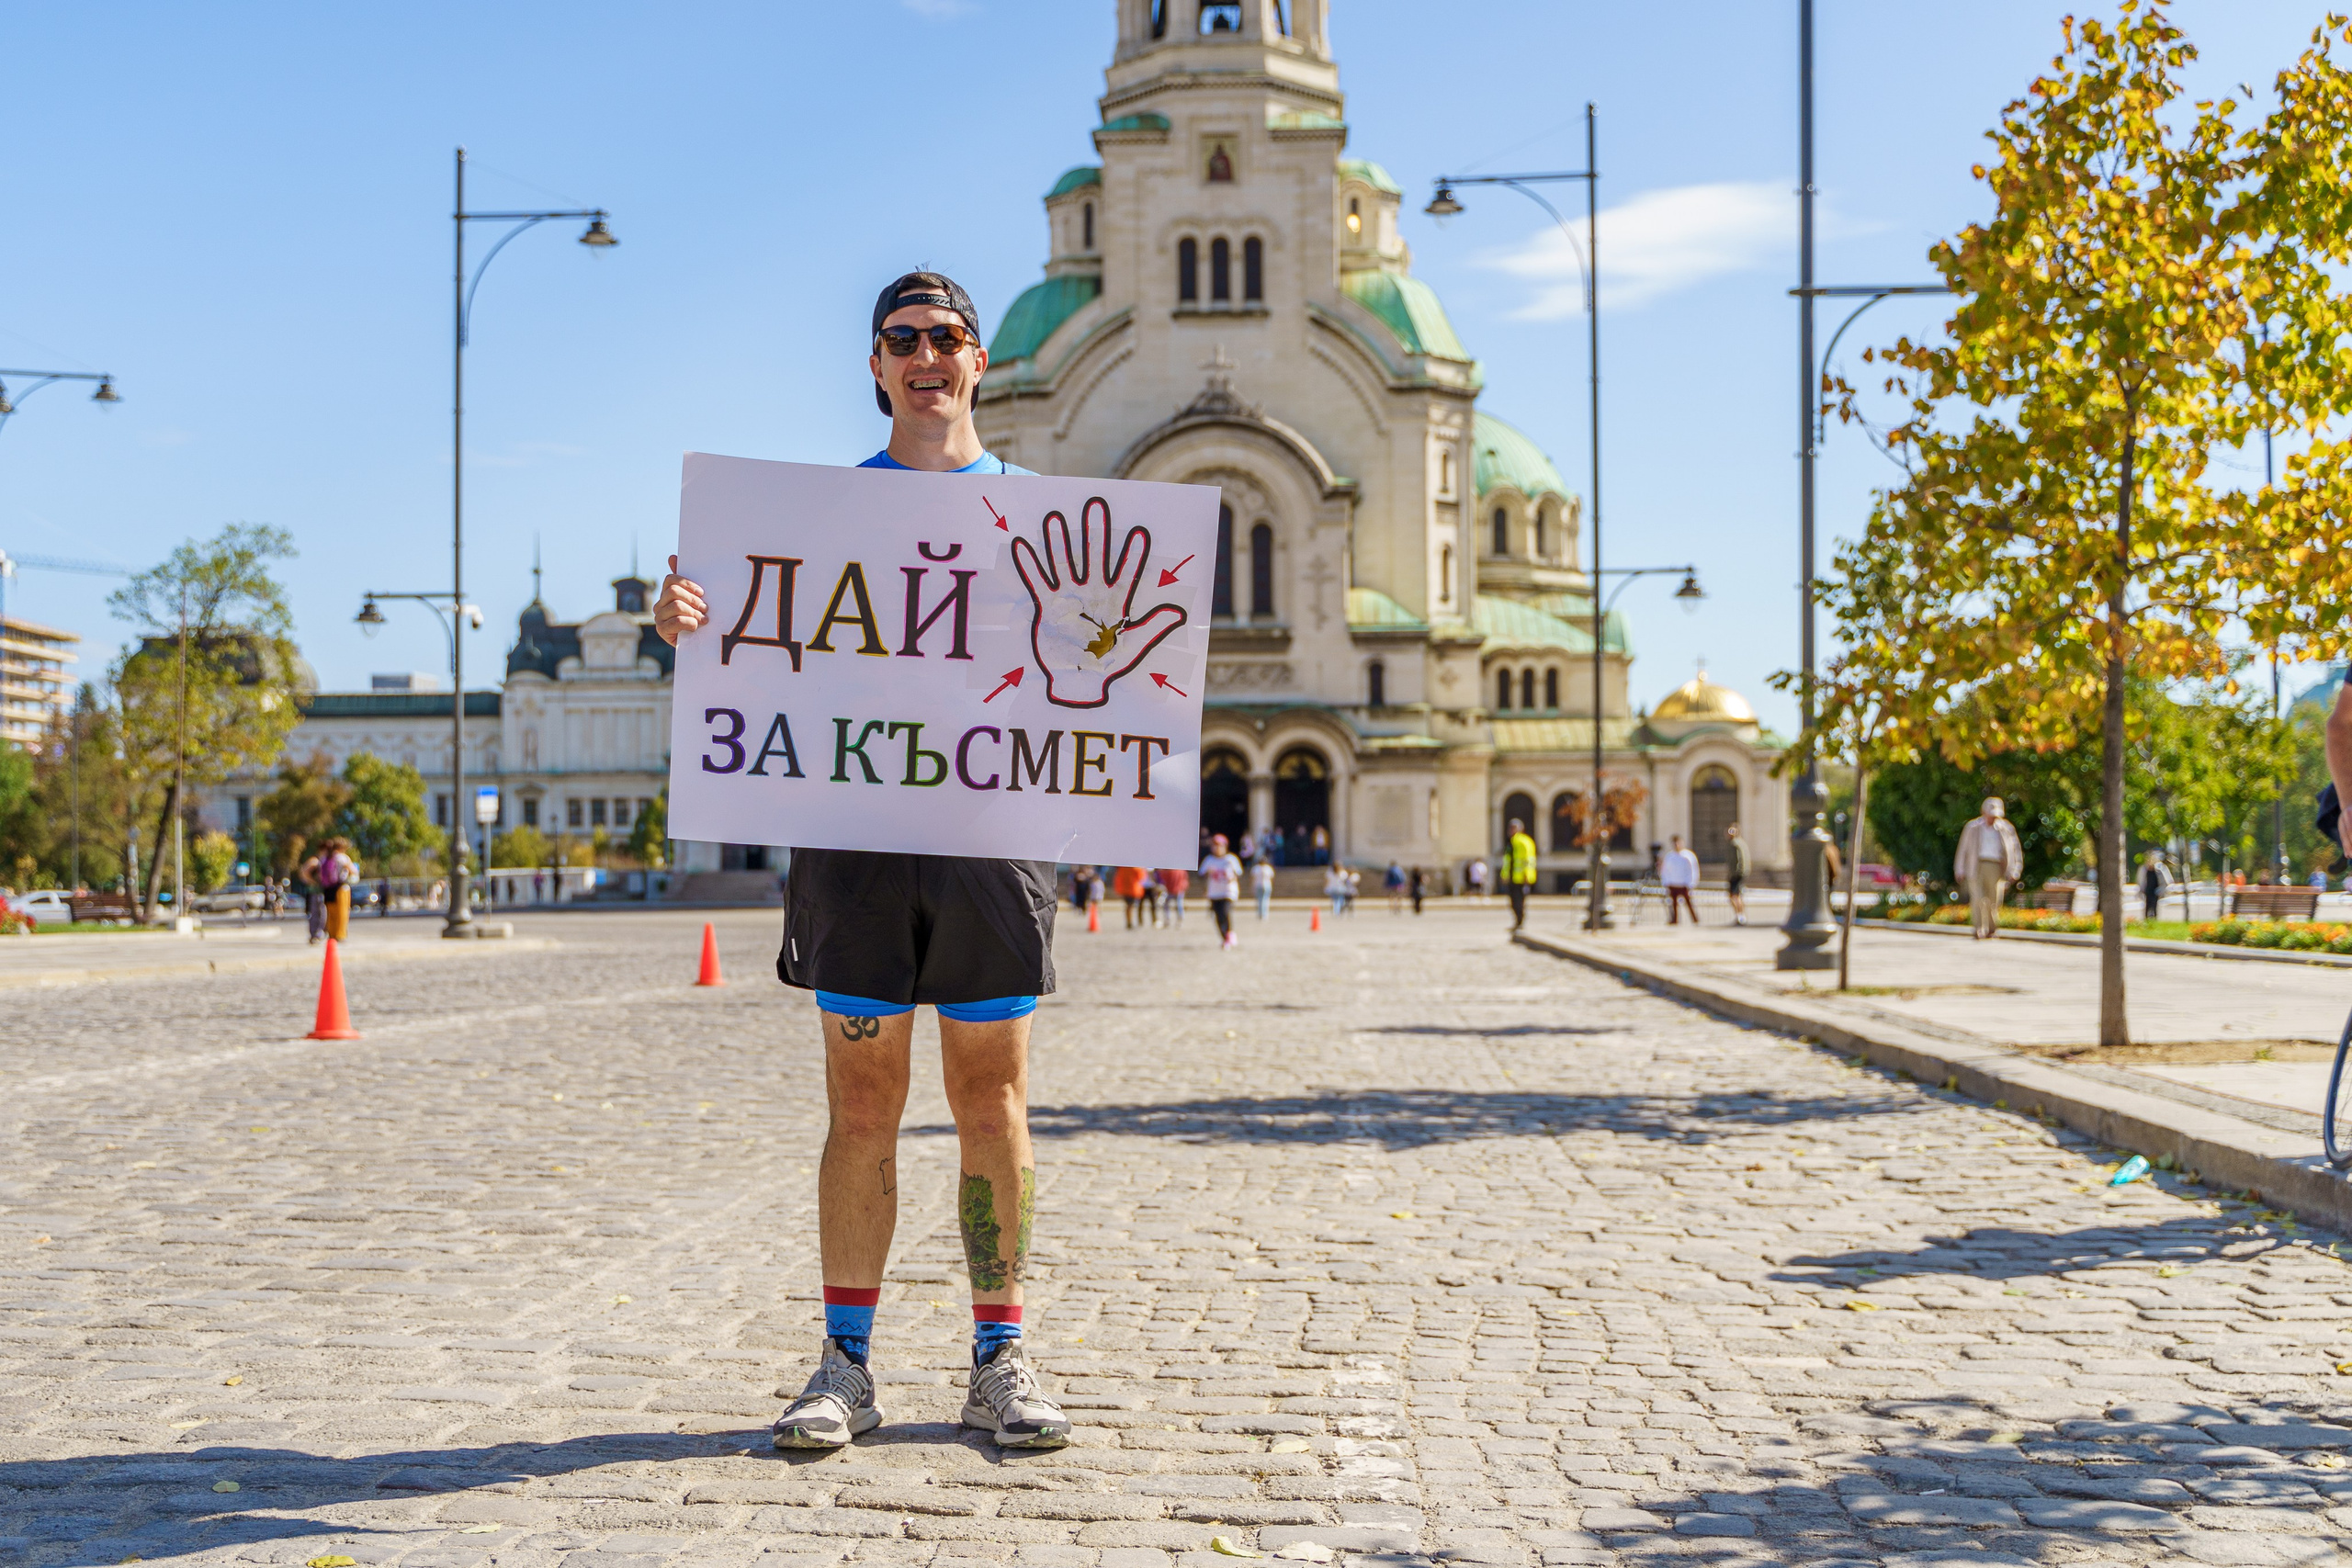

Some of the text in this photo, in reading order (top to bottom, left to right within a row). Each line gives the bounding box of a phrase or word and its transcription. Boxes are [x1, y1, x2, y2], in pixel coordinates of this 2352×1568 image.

[721, 541, 978, 673] ДАЙ
[701, 707, 1170, 801] ЗА КЪСМЕТ
